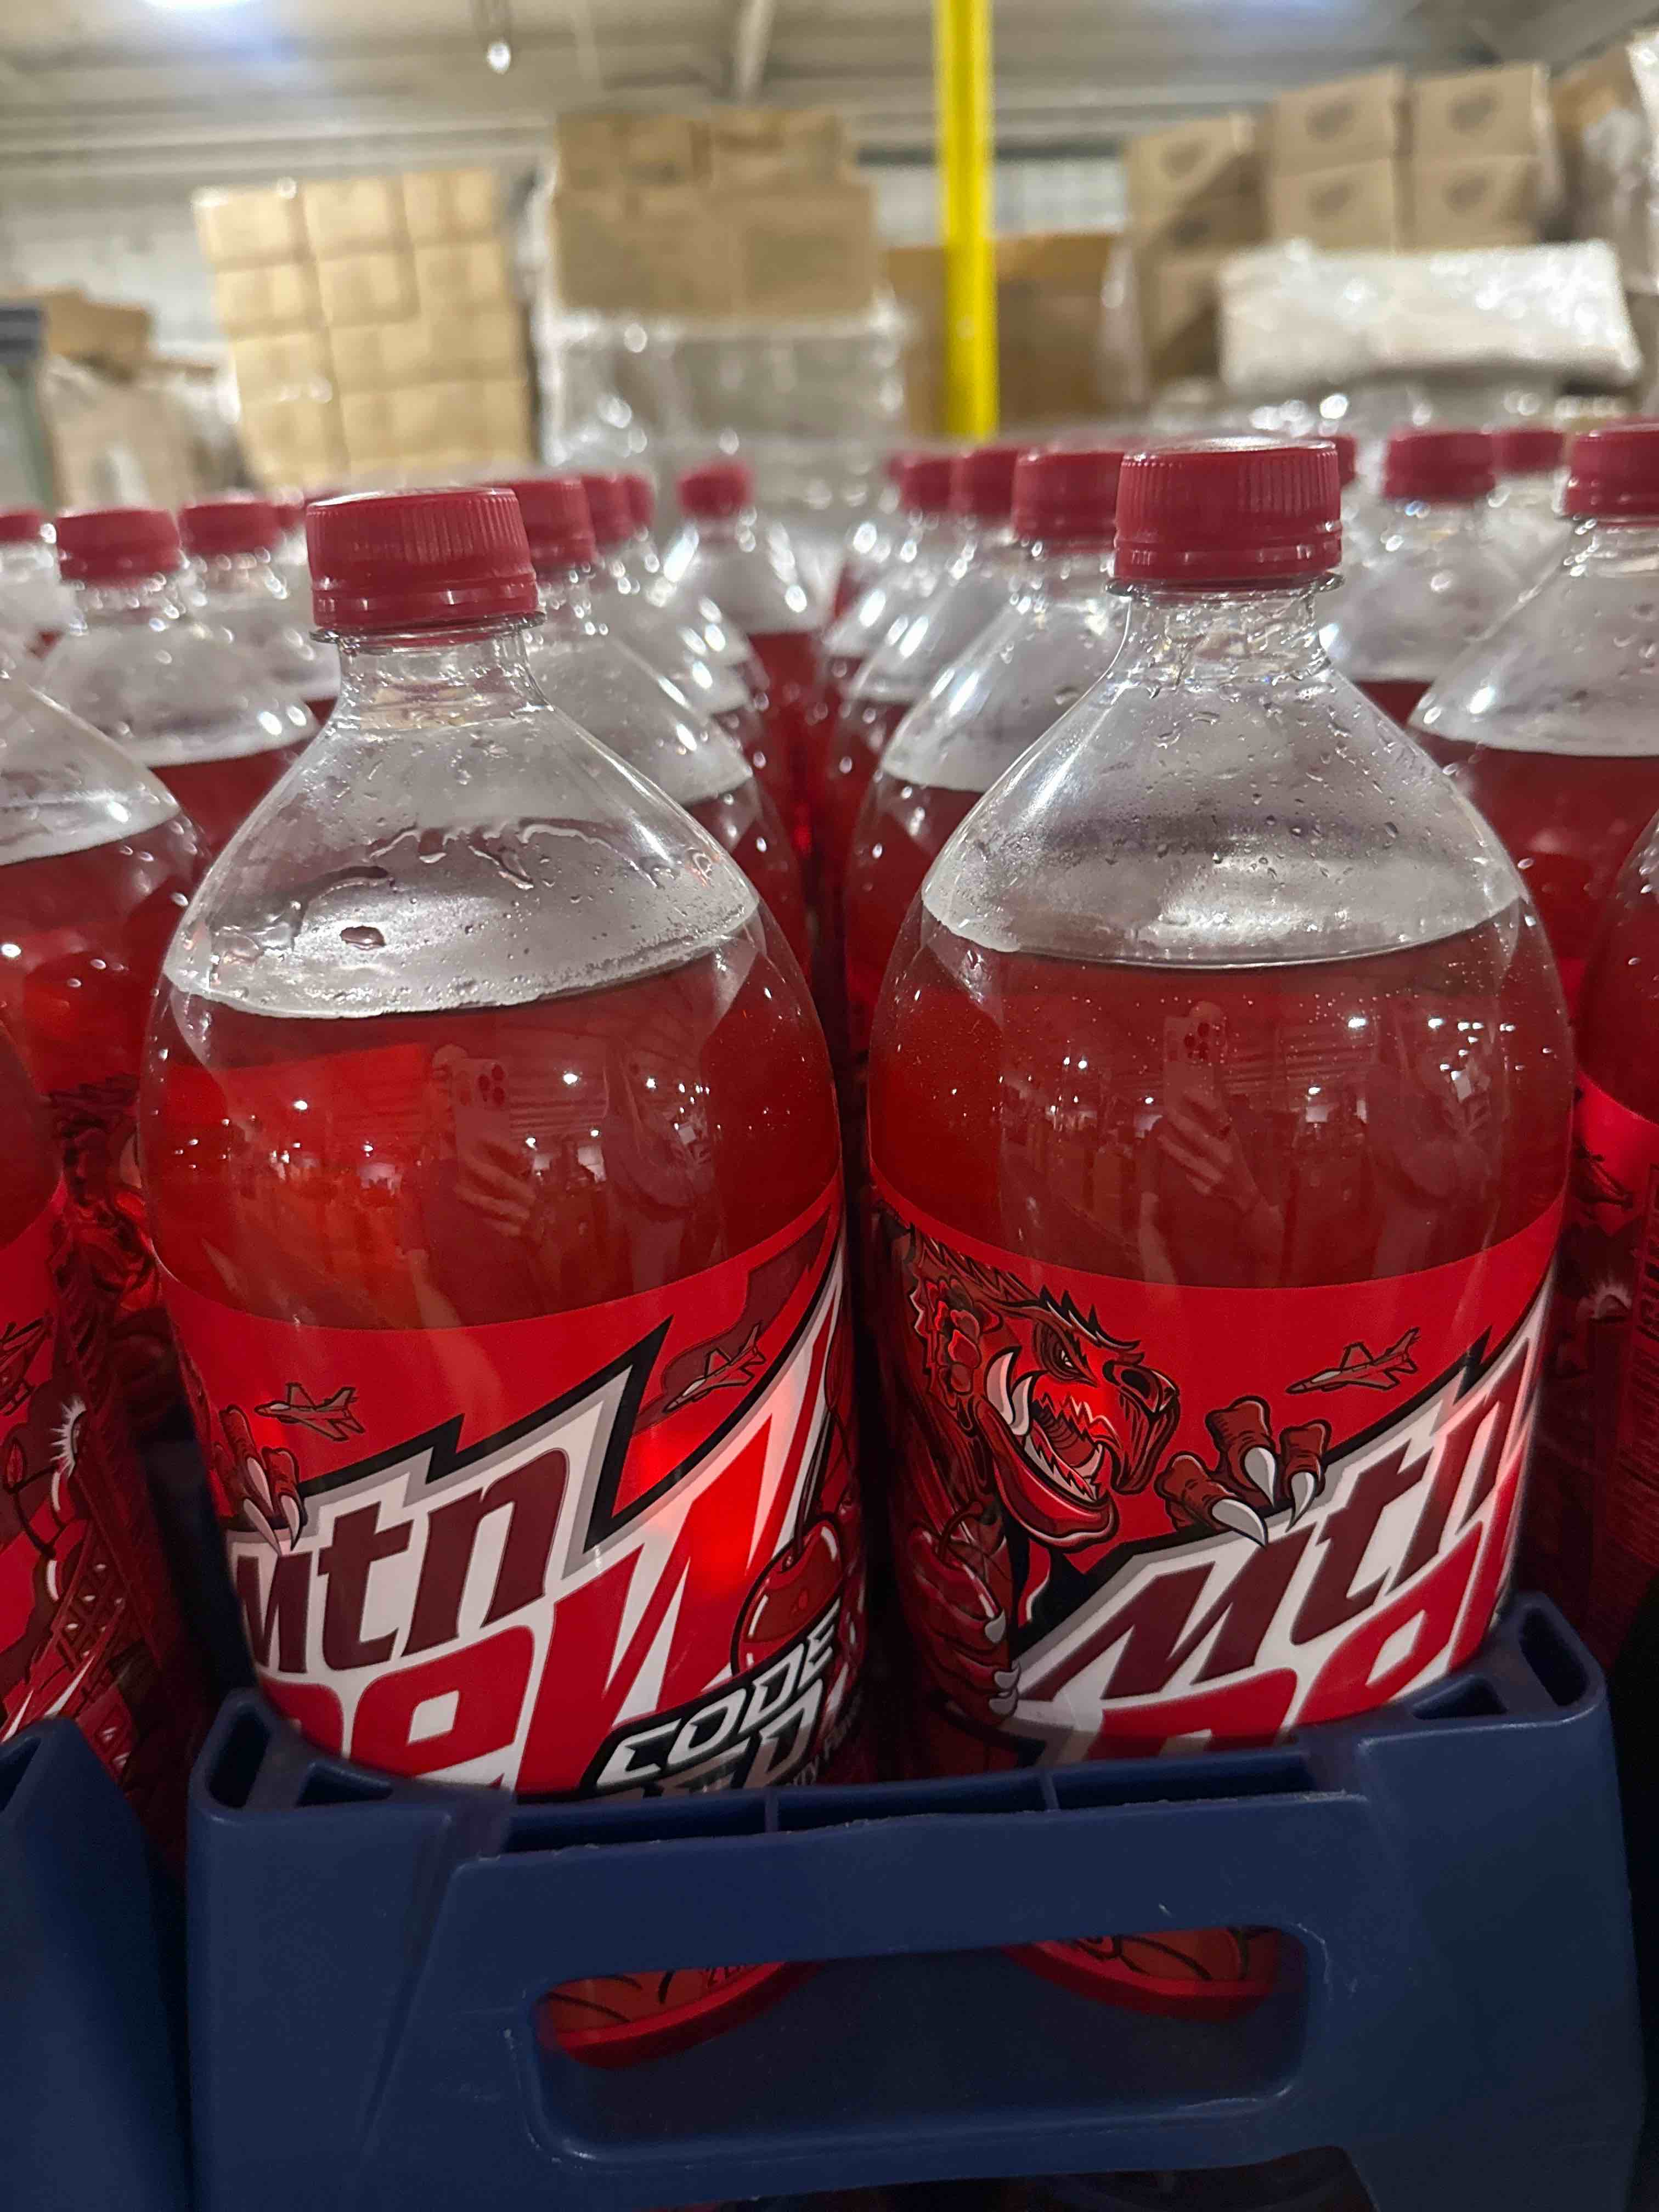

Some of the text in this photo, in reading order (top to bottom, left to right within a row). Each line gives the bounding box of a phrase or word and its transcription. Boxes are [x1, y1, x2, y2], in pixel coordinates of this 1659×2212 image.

[236, 1447, 569, 1673] Mtn
[1018, 1338, 1531, 1700] Mtn
[596, 1595, 841, 1787] CODE
